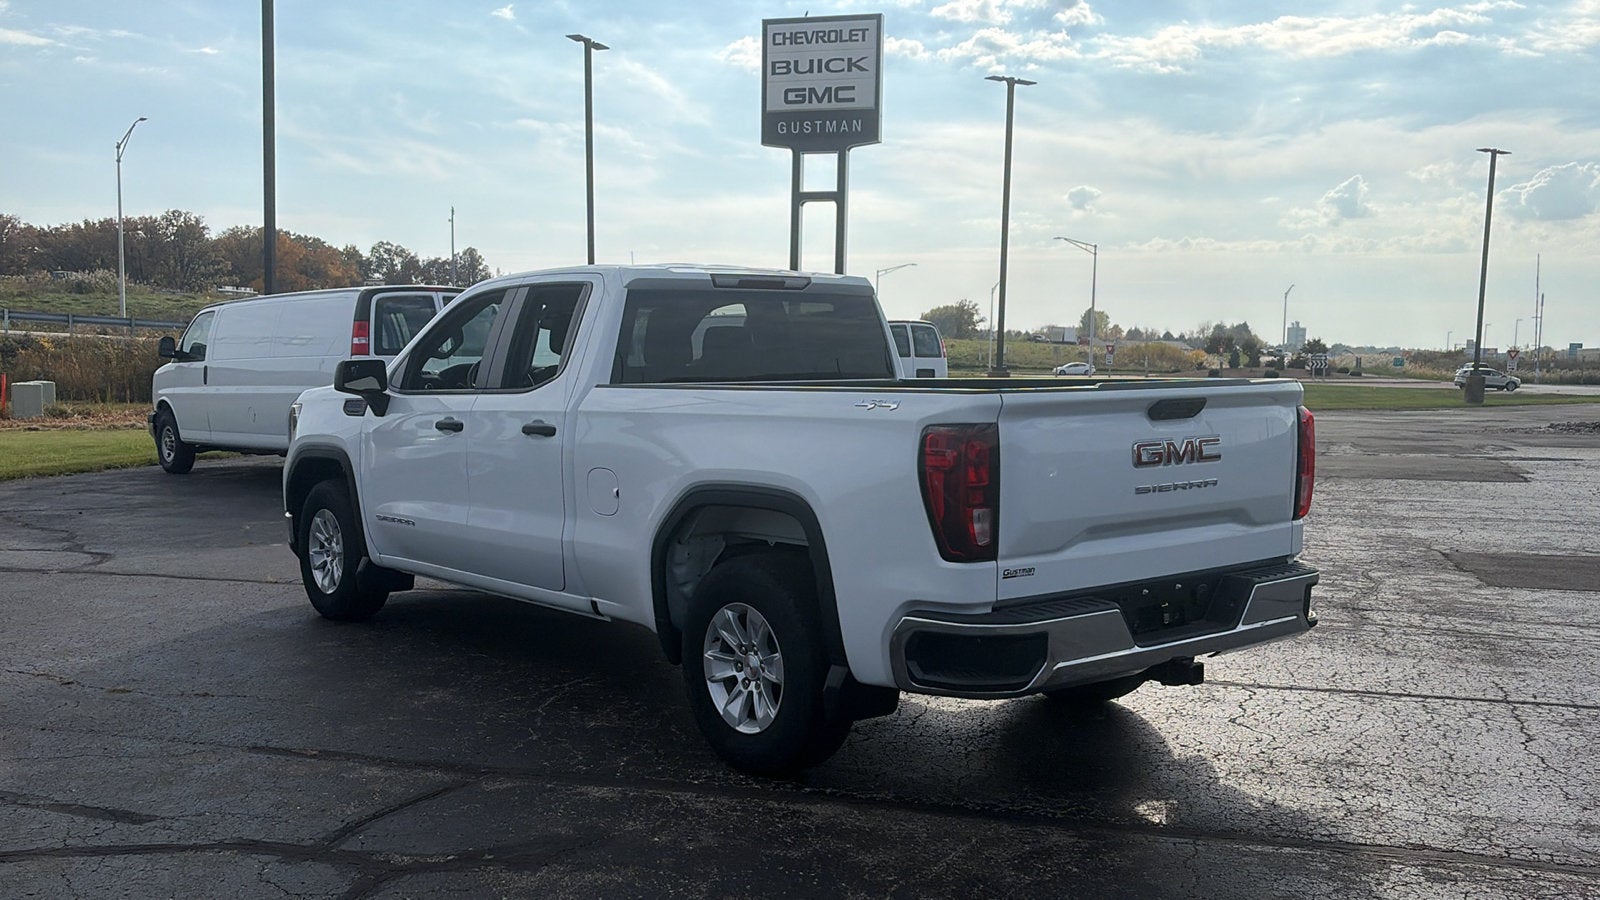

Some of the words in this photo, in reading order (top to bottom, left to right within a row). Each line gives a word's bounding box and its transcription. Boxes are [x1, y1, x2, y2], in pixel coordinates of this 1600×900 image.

[772, 28, 869, 46] CHEVROLET
[771, 56, 869, 76] BUICK
[784, 85, 856, 105] GMC
[777, 119, 862, 134] GUSTMAN
[1132, 436, 1222, 468] GMC
[1135, 478, 1218, 494] SIERRA
[375, 513, 416, 527] SIERRA
